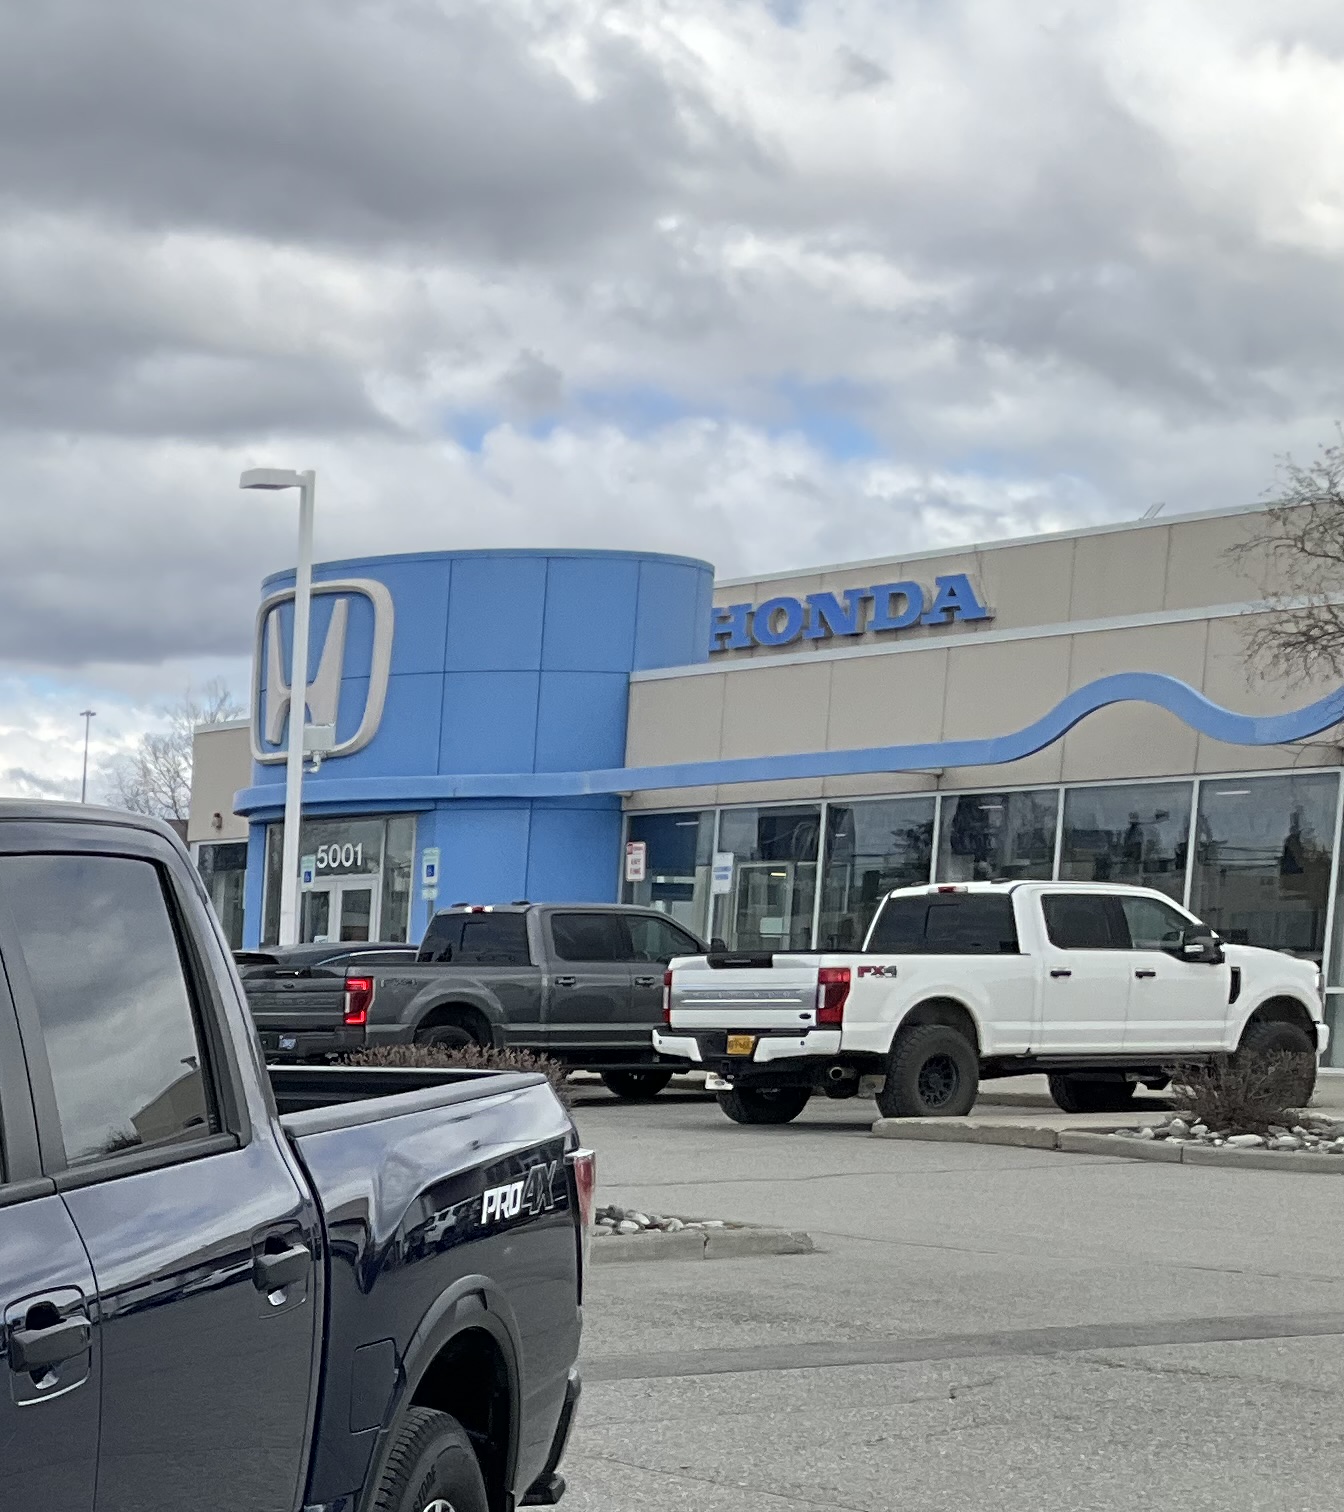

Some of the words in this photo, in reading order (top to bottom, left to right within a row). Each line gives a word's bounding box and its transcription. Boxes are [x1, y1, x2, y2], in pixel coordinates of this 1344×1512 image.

[711, 573, 988, 652] HONDA
[316, 842, 363, 869] 5001
[857, 965, 897, 978] FX4
